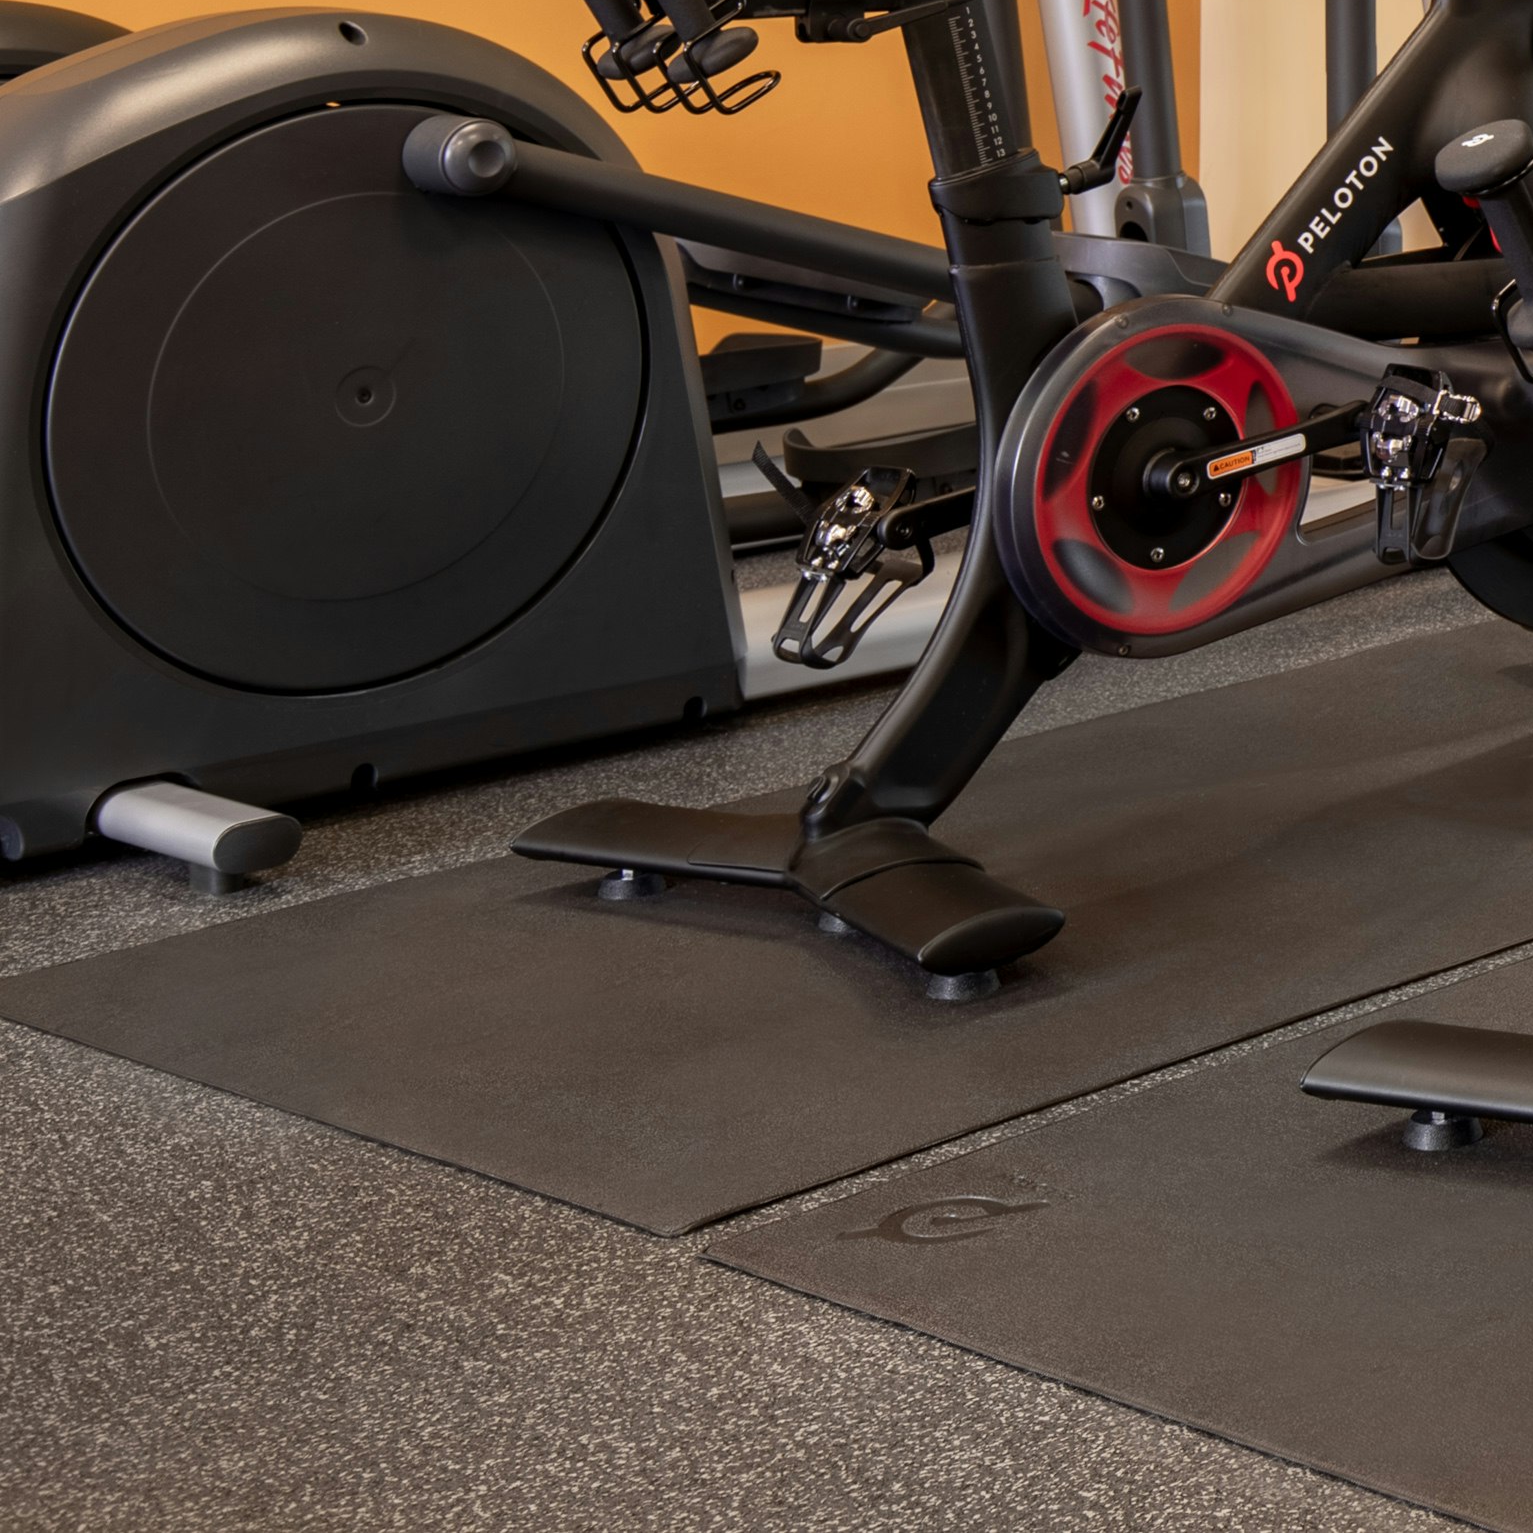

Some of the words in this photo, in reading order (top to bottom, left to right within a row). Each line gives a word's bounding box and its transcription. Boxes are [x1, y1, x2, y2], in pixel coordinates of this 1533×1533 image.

[988, 113, 998, 122] 10
[990, 125, 999, 134] 11
[993, 136, 1003, 145] 12
[996, 148, 1006, 158] 13
[1297, 136, 1394, 254] PELOTON
[1219, 455, 1250, 469] CAUTION
